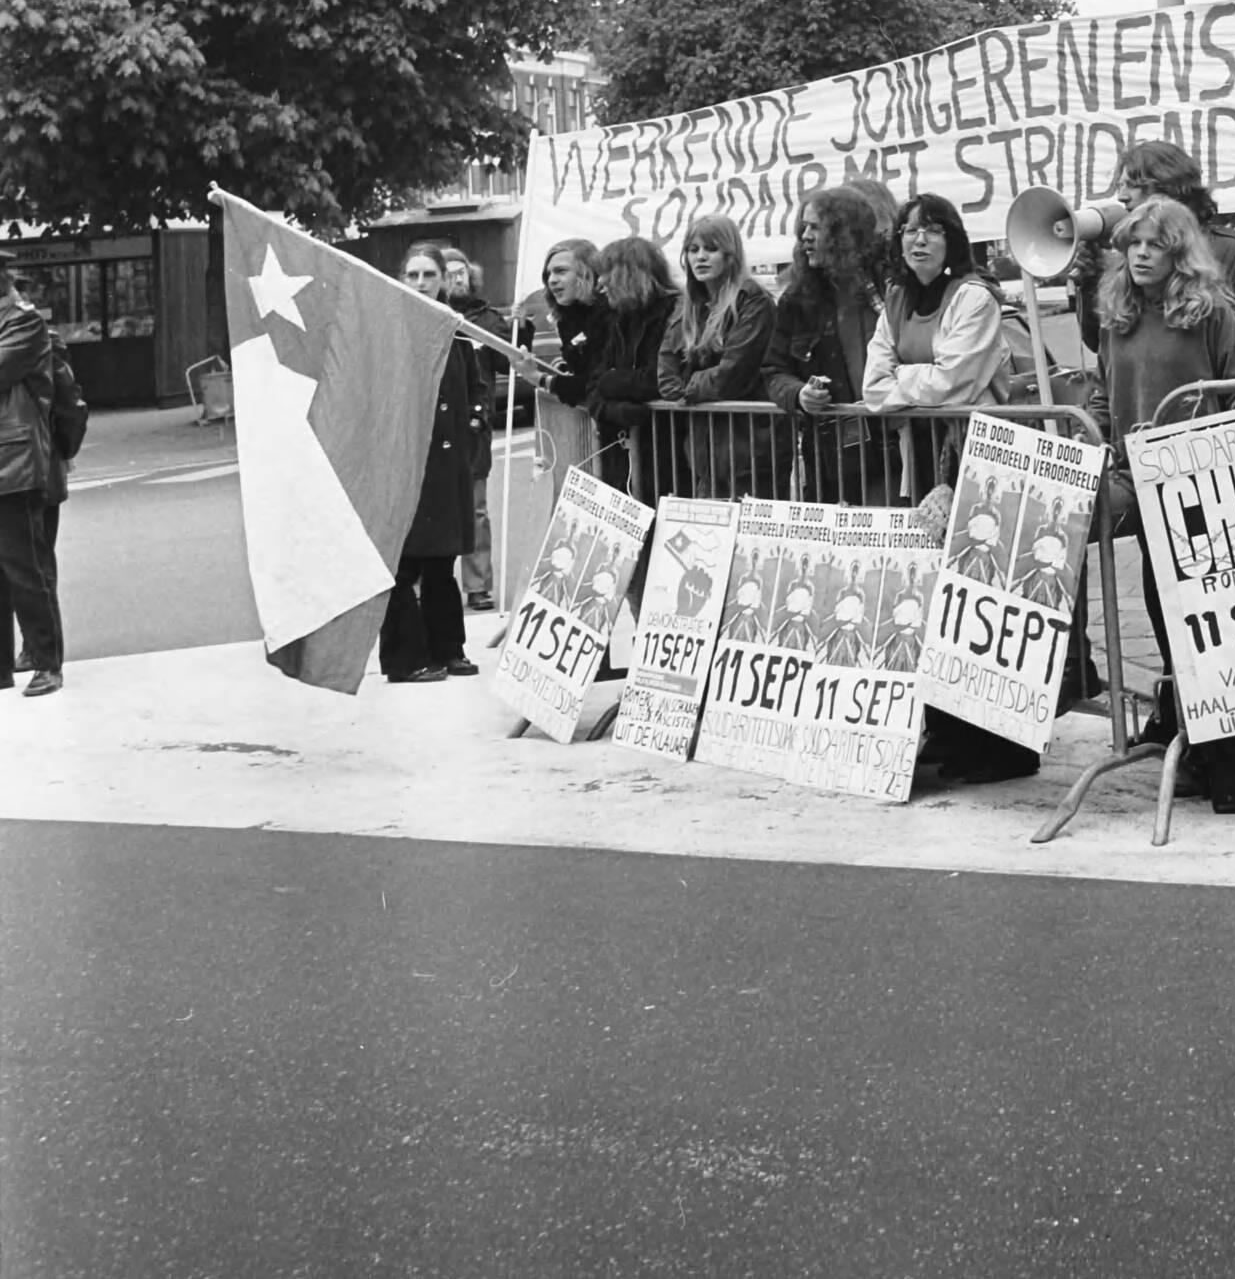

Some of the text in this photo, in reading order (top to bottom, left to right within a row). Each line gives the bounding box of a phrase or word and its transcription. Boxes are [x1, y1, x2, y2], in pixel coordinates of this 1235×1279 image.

[548, 85, 815, 206] WERKENDE
[831, 19, 1100, 150] JONGEREN
[1111, 11, 1193, 112] EN
[843, 140, 929, 200] MET
[968, 438, 1030, 472] VEROORDEELD
[971, 419, 1015, 447] TER DOOD
[1036, 437, 1083, 466] TER DOOD
[1032, 456, 1099, 493] VEROORDEELD
[890, 514, 904, 529] TER
[516, 601, 548, 650] 11
[538, 615, 606, 687] SEPT
[642, 632, 706, 676] 11 SEPT
[939, 582, 1072, 686] 11 SEPT
[1184, 611, 1222, 654] 11
[715, 647, 744, 703] 11
[740, 653, 813, 718] SEPT
[814, 676, 840, 720] 11
[844, 677, 914, 730] SEPT
